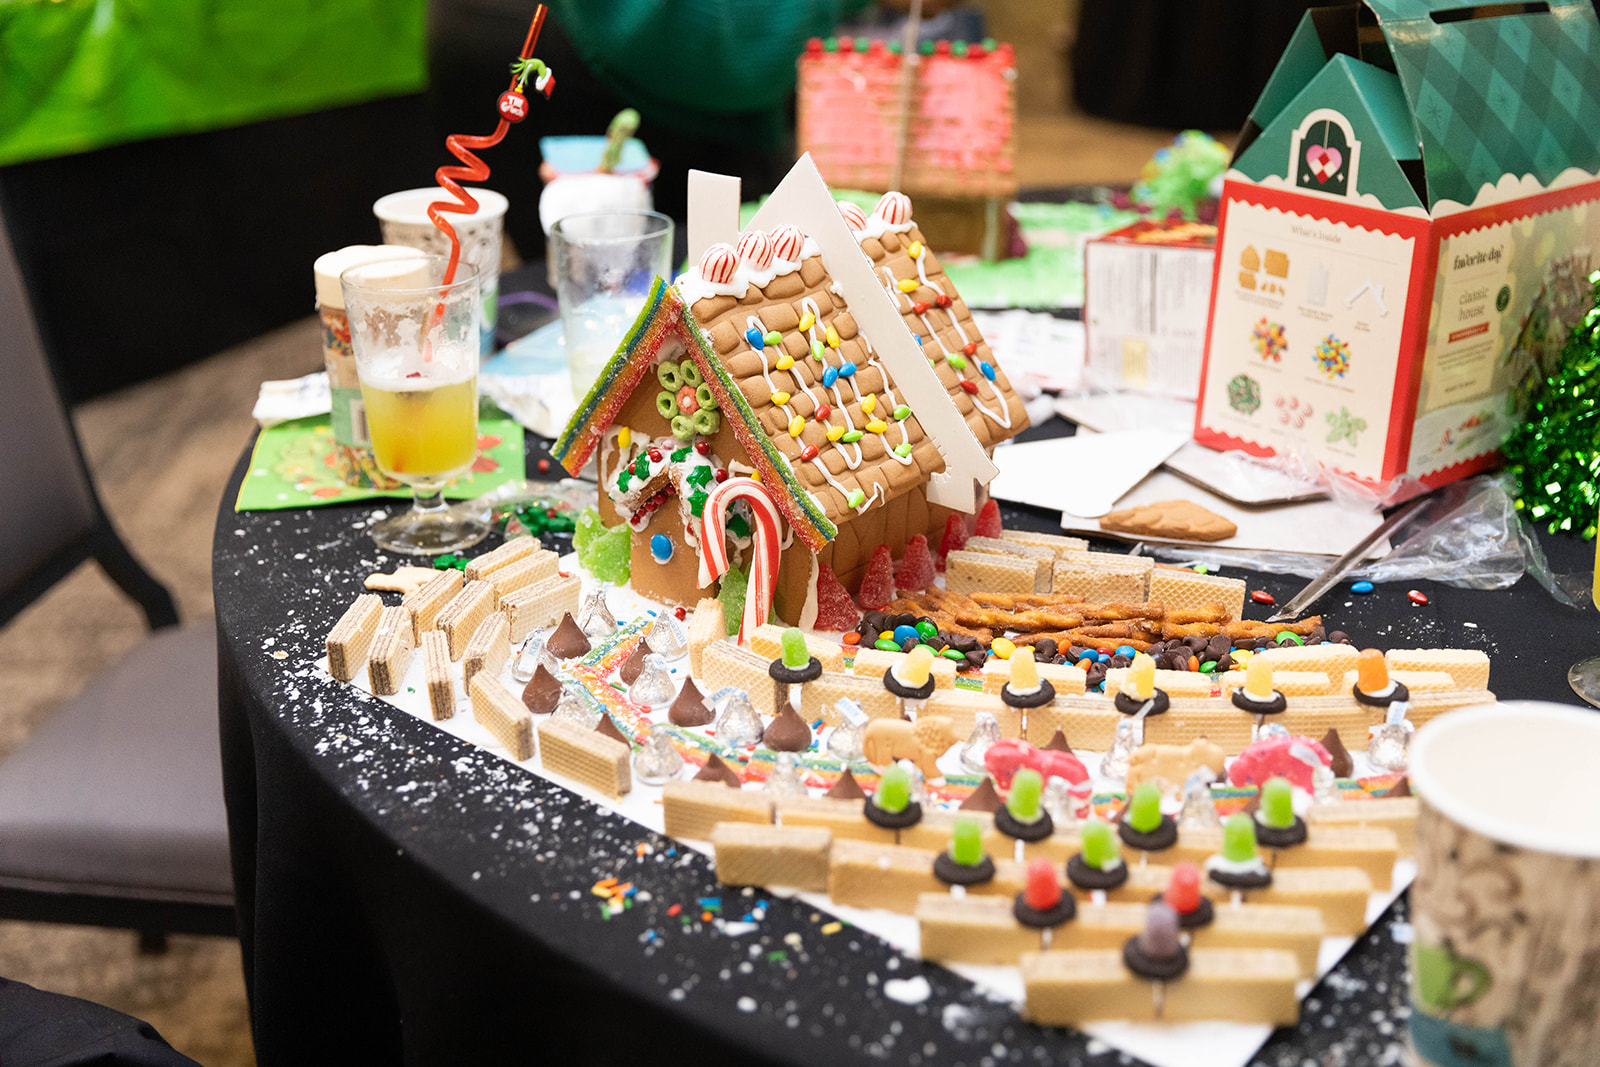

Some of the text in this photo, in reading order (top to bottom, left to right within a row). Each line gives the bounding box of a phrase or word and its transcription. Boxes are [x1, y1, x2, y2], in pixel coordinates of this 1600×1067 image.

[1453, 252, 1486, 270] favorite
[1459, 286, 1489, 305] classic
[1458, 304, 1485, 321] house
